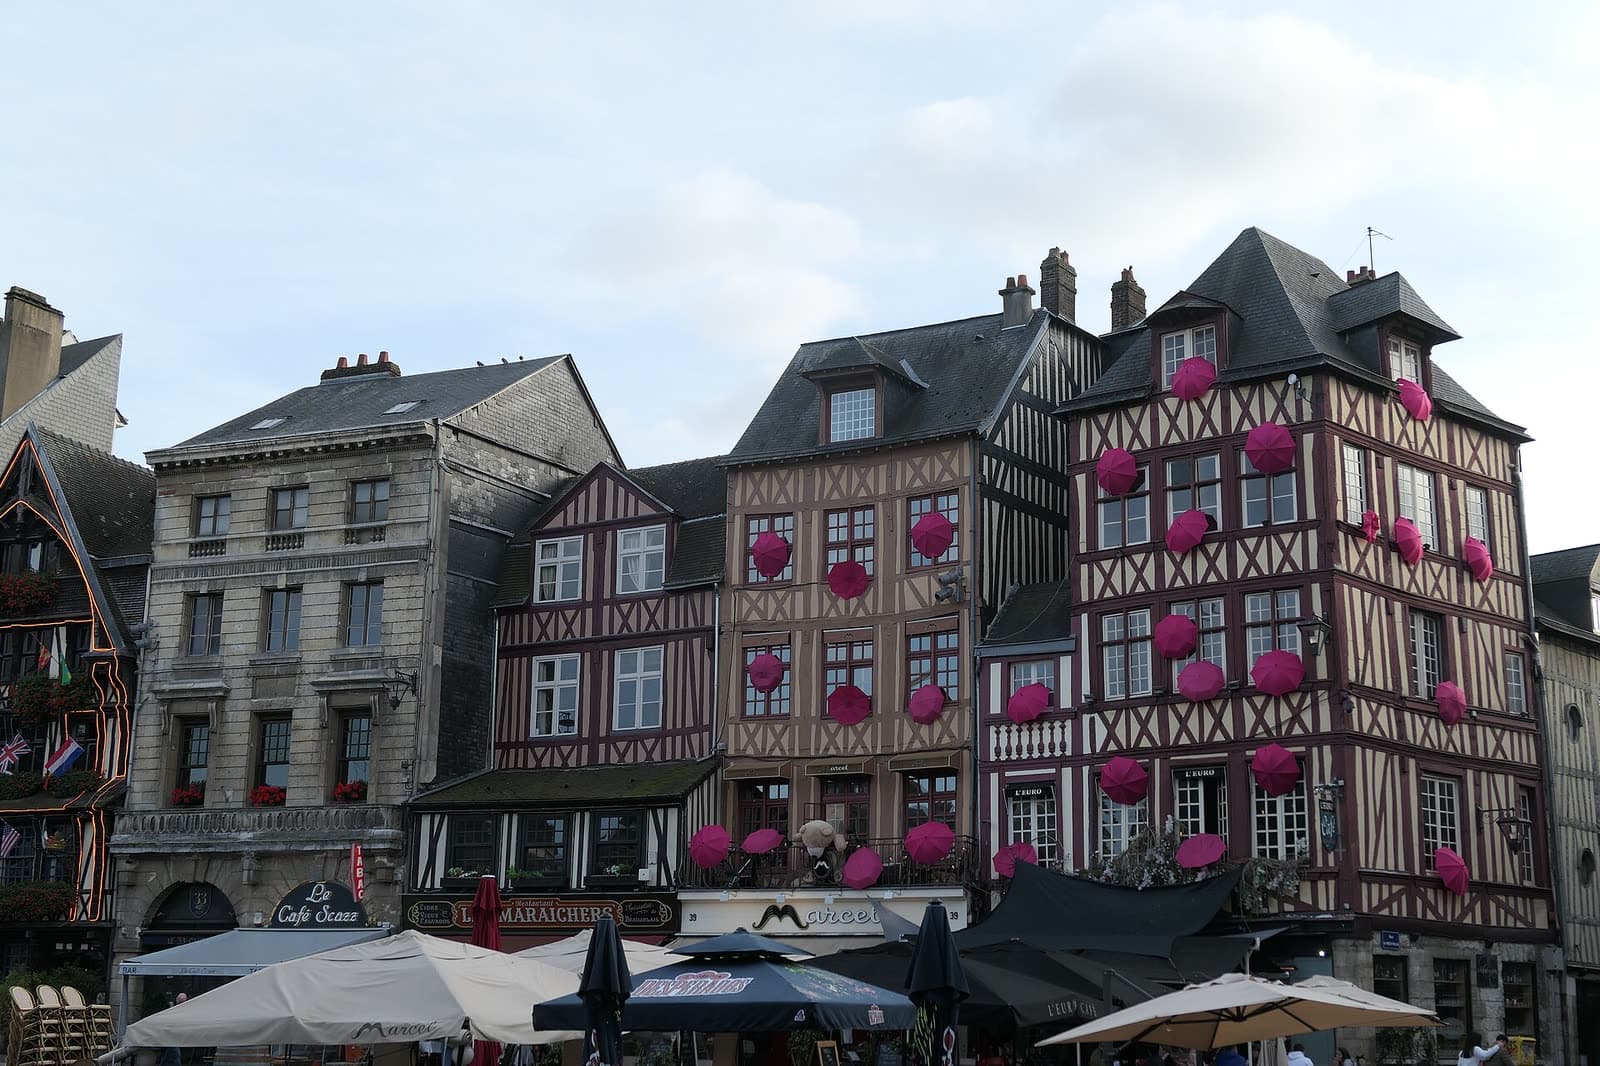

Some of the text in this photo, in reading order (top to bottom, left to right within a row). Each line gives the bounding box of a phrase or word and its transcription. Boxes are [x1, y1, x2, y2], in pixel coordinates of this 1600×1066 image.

[1185, 769, 1215, 778] L'EURO
[1015, 788, 1042, 796] L'EURO
[356, 845, 364, 899] TABAC
[305, 883, 331, 903] Le
[278, 904, 359, 927] Café Scazz
[689, 913, 697, 922] 39
[949, 911, 959, 920] 39
[351, 1021, 437, 1040] Marcel
